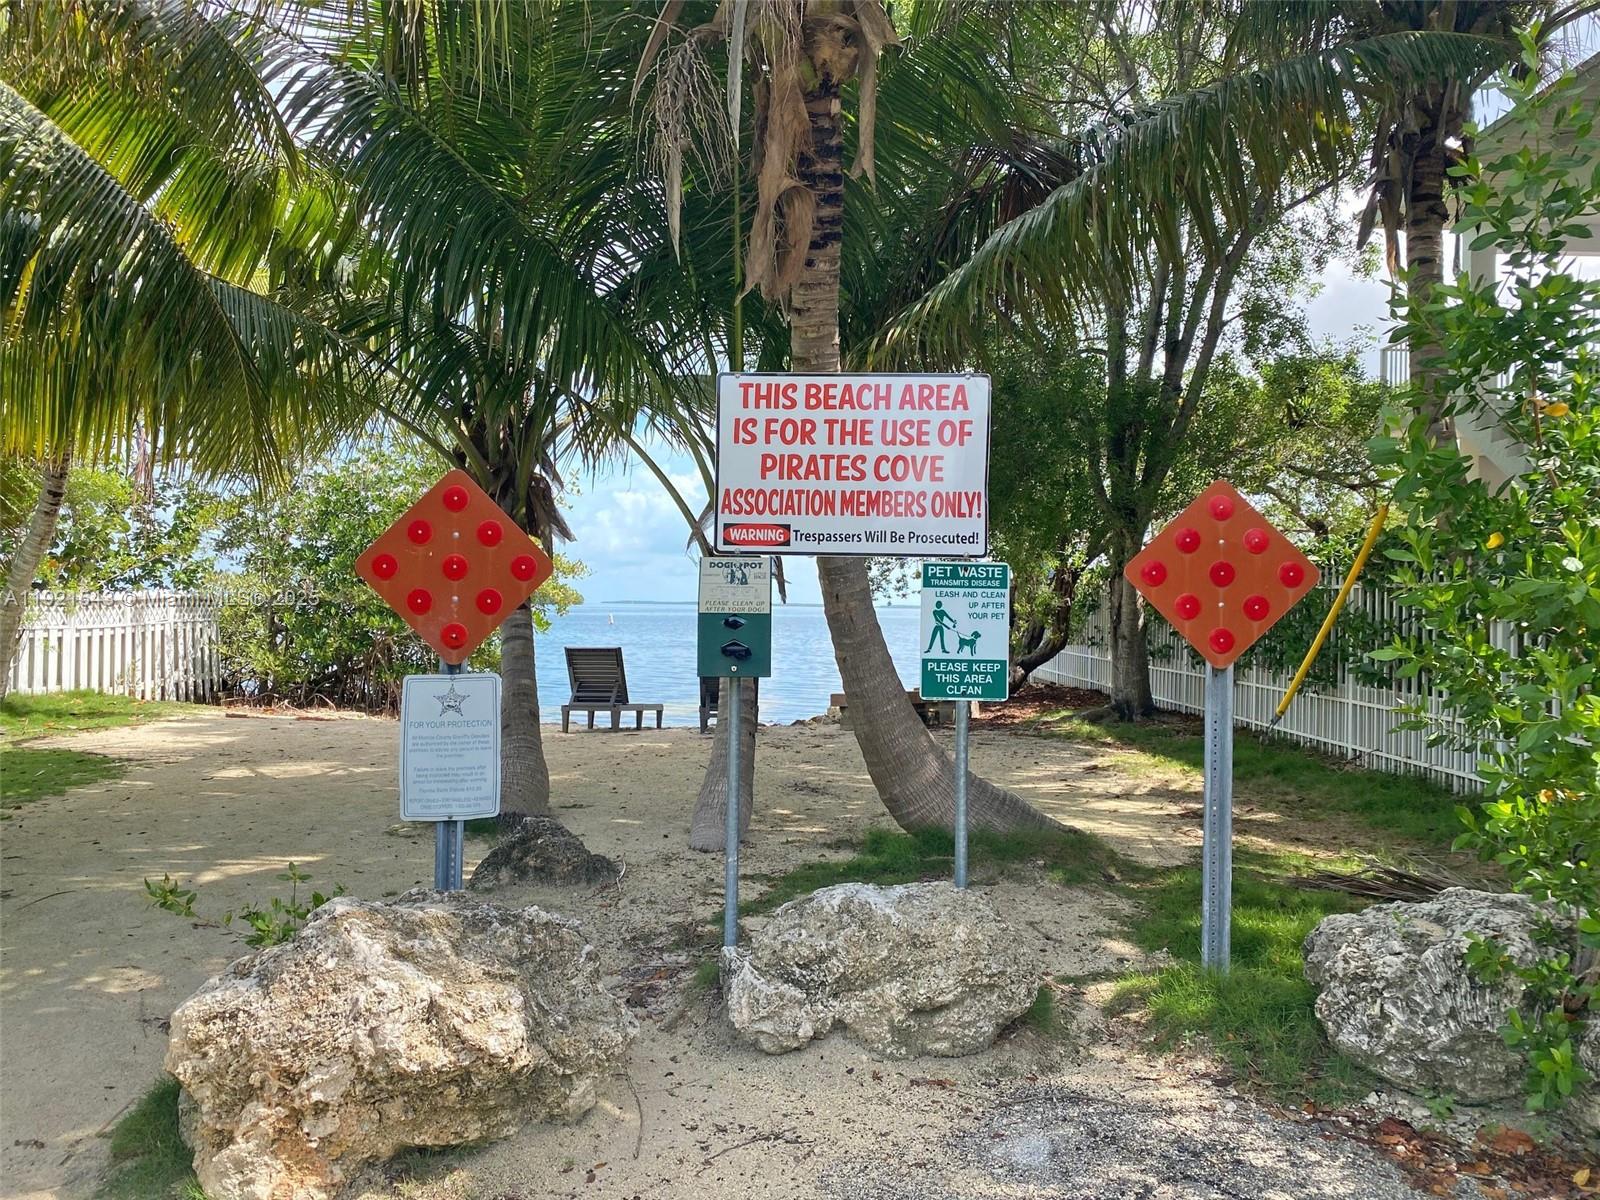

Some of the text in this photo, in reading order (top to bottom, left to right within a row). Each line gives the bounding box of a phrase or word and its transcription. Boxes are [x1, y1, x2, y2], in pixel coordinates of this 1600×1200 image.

[738, 382, 969, 411] THIS BEACH AREA
[733, 417, 974, 447] IS FOR THE USE OF
[760, 453, 945, 482] PIRATES COVE
[720, 488, 982, 518] ASSOCIATION MEMBERS ONLY!
[729, 528, 980, 545] WARNING Trespassers Will Be Prosecuted!
[927, 566, 1003, 578] PET WASTE
[930, 579, 1001, 587] TRANSMITS DISEASE
[935, 590, 960, 598] LEASH
[980, 591, 1006, 599] CLEAN
[968, 612, 988, 620] YOUR
[927, 662, 1001, 673] PLEASE KEEP
[935, 673, 993, 684] THIS AREA
[409, 719, 493, 729] FOR YOUR PROTECTION
